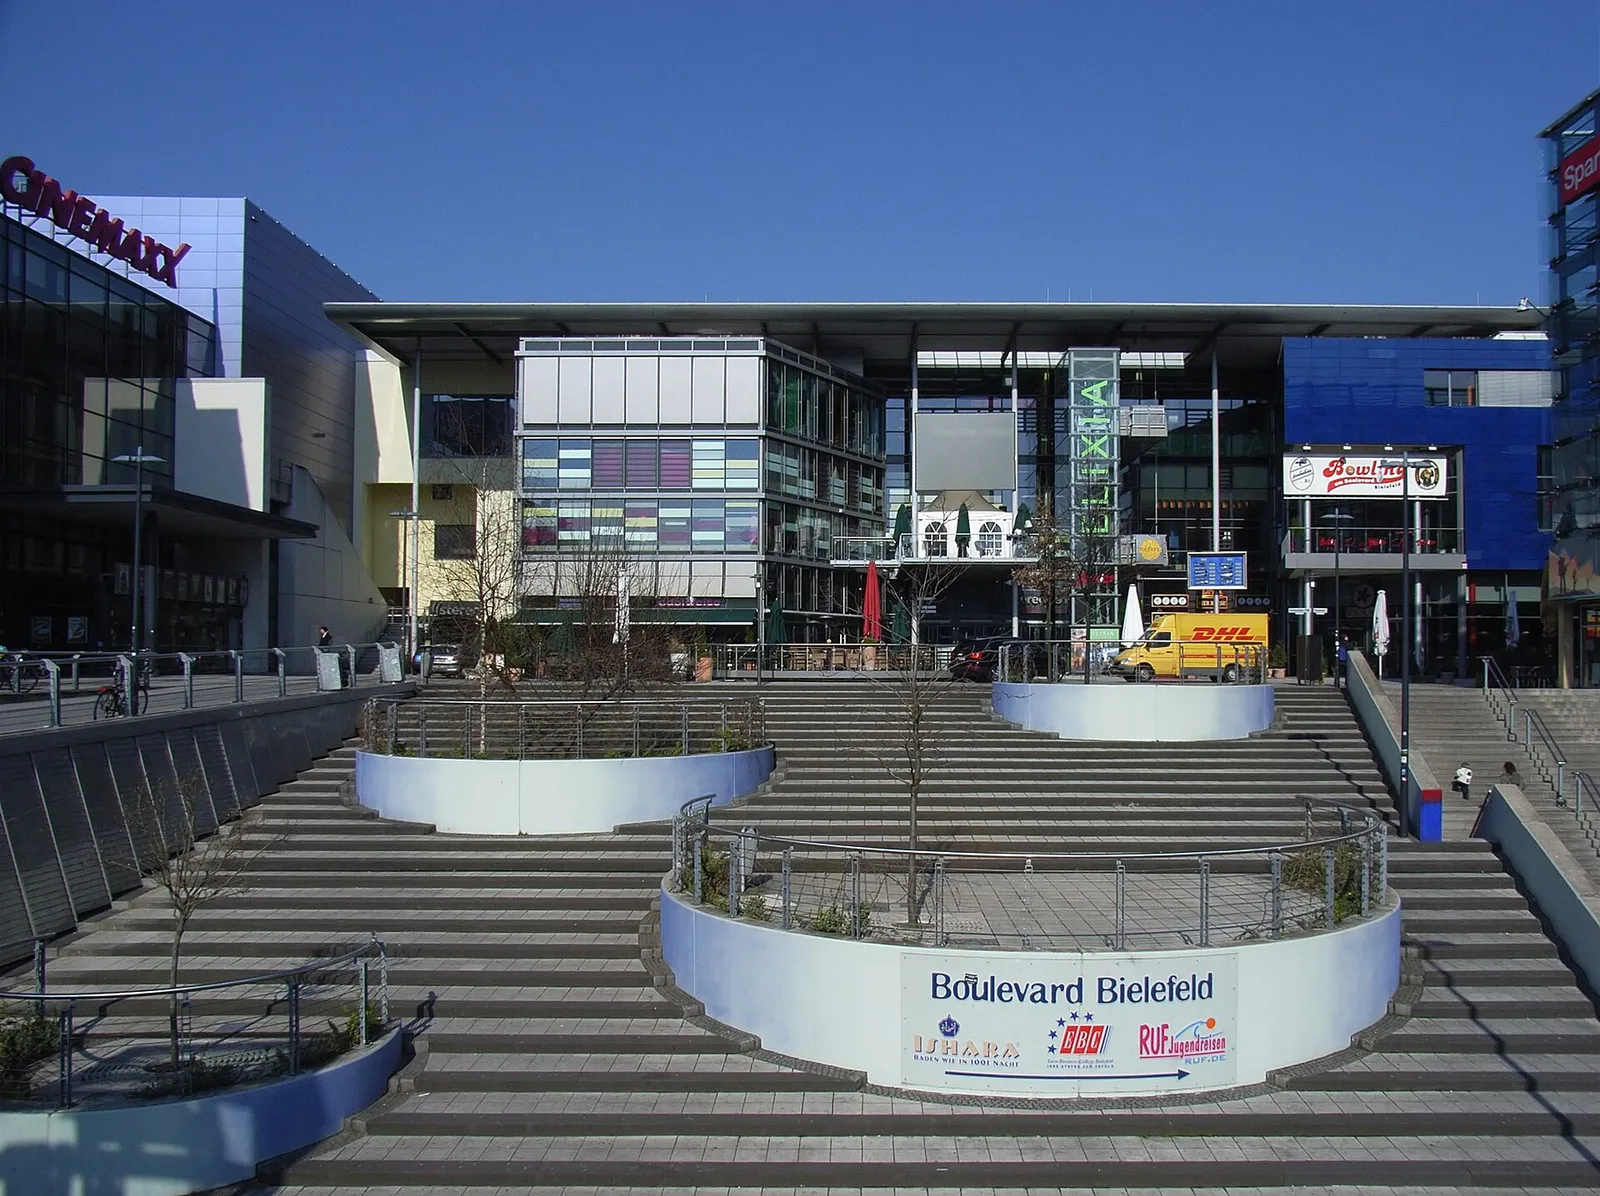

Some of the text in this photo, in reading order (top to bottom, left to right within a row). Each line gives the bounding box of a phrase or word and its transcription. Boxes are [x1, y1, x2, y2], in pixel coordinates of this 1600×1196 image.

[0, 156, 192, 289] CINEMAXX
[1191, 627, 1256, 641] DHL
[932, 972, 1213, 1004] Boulevard Bielefeld
[914, 1035, 1020, 1059] ISHARA
[1062, 1029, 1102, 1050] EBC
[1139, 1023, 1226, 1058] RUF Jugendreisen
[913, 1054, 939, 1062] BADEN
[1185, 1055, 1226, 1065] RUF.DE
